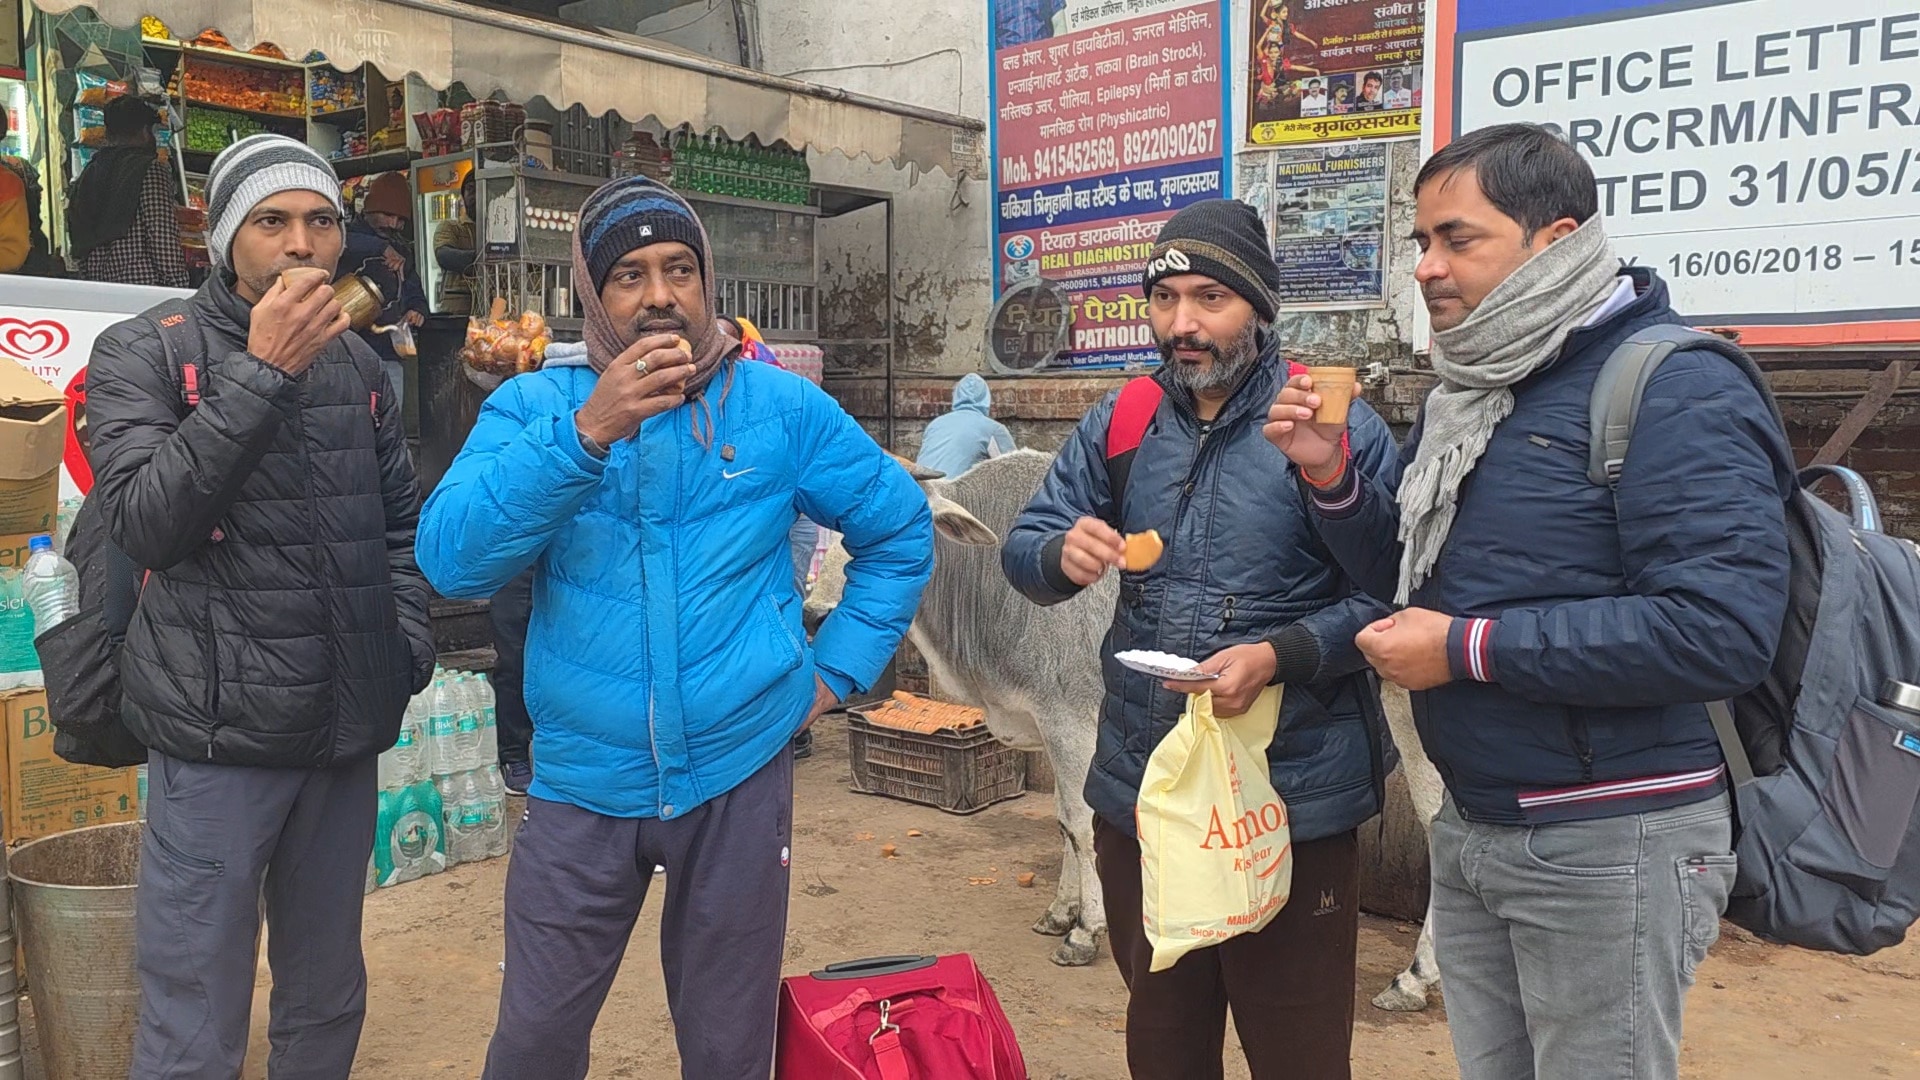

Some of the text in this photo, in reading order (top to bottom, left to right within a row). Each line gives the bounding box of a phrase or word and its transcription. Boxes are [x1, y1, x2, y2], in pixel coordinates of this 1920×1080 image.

[1022, 47, 1046, 68] प्रेशर,
[1048, 43, 1069, 66] शुगर
[1132, 21, 1165, 42] जनरल
[1167, 10, 1212, 35] मेडिसिन,
[1065, 61, 1093, 83] अटैक,
[1094, 58, 1122, 77] लकवा
[1125, 51, 1159, 74] (Brain
[1161, 40, 1207, 64] Strock),
[1492, 44, 1694, 108] OFFICE
[1096, 83, 1142, 105] Epilepsy
[1174, 72, 1188, 88] का
[1191, 63, 1218, 84] दौरा)
[1039, 100, 1171, 139] मानसिक रोग (Physhicatric)
[1312, 113, 1412, 138] मुगलसराय
[1002, 154, 1032, 185] Mob.
[1034, 135, 1120, 181] 9415452569,
[1123, 118, 1217, 165] 8922090267
[1279, 156, 1385, 176] NATIONAL FURNISHERS
[1001, 193, 1032, 219] चकिया
[1119, 176, 1131, 203] के
[1133, 179, 1158, 200] पास,
[1160, 170, 1219, 208] मुगलसराय
[1596, 169, 1708, 217] TED
[1041, 230, 1076, 252] रियल
[1041, 253, 1071, 271] REAL
[1115, 261, 1148, 273] PATHOLO
[1667, 244, 1842, 278] 16/06/2018
[1104, 352, 1126, 362] Prasad
[1190, 928, 1215, 938] SHOP
